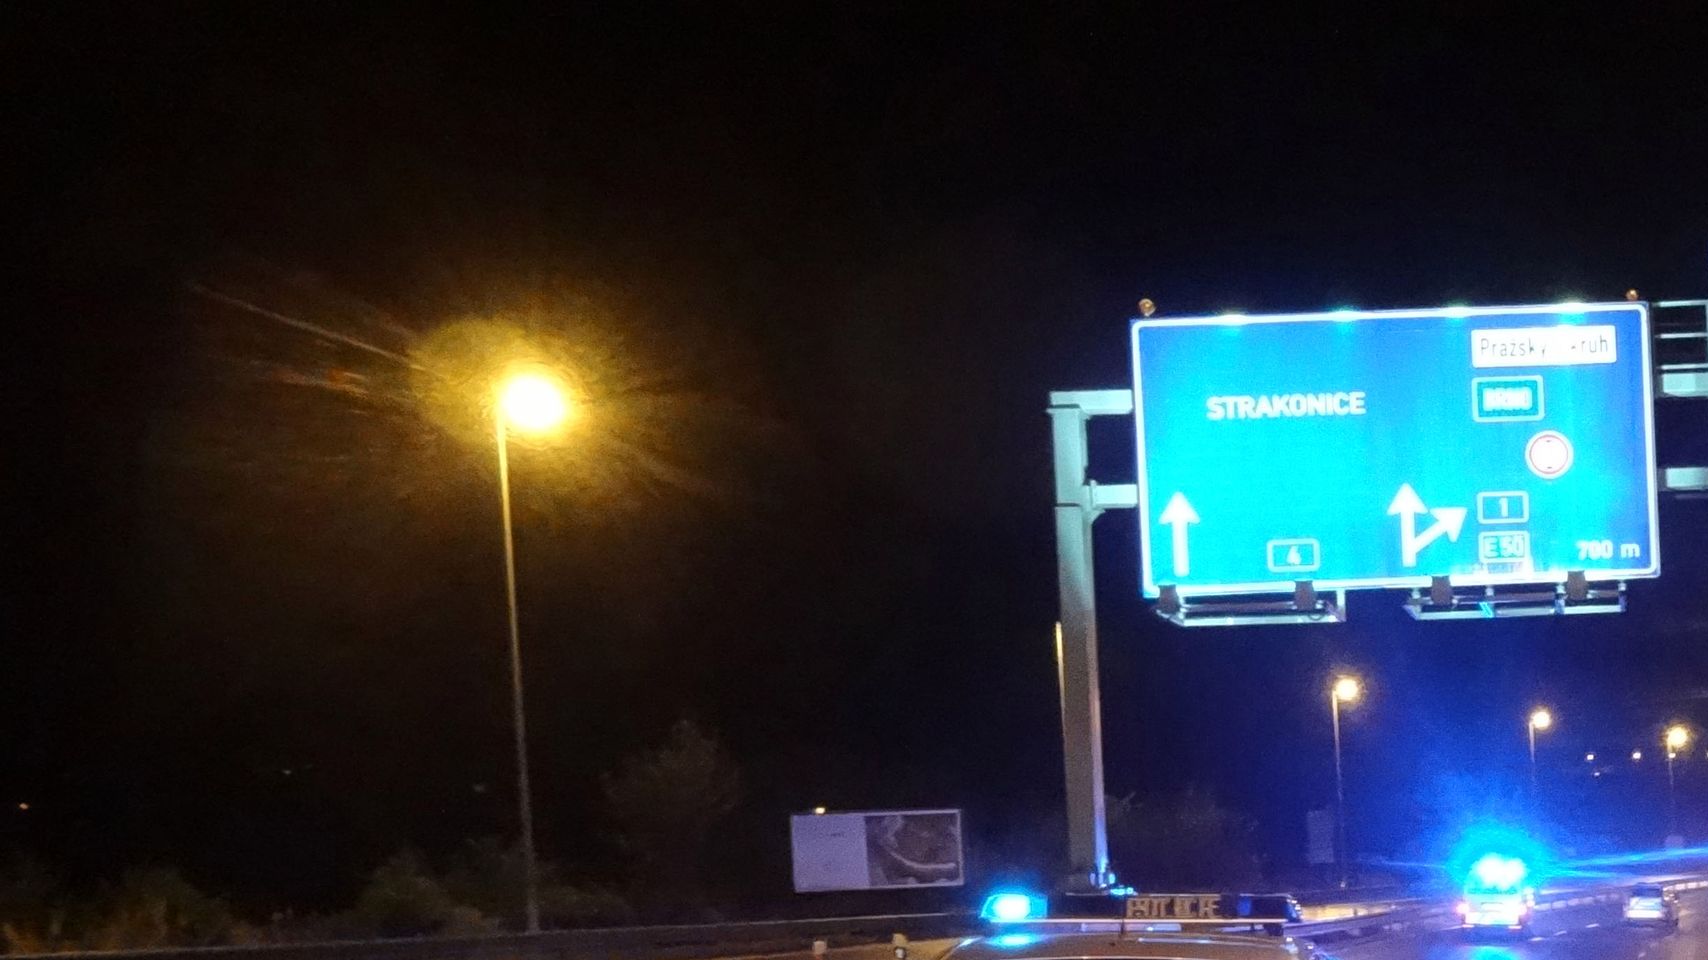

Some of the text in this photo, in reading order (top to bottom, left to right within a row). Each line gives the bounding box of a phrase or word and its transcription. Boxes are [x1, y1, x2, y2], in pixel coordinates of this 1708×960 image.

[1206, 391, 1367, 421] STRAKONICE
[1499, 497, 1509, 518] 1
[1485, 534, 1524, 559] E 50
[1577, 540, 1641, 561] 700 m
